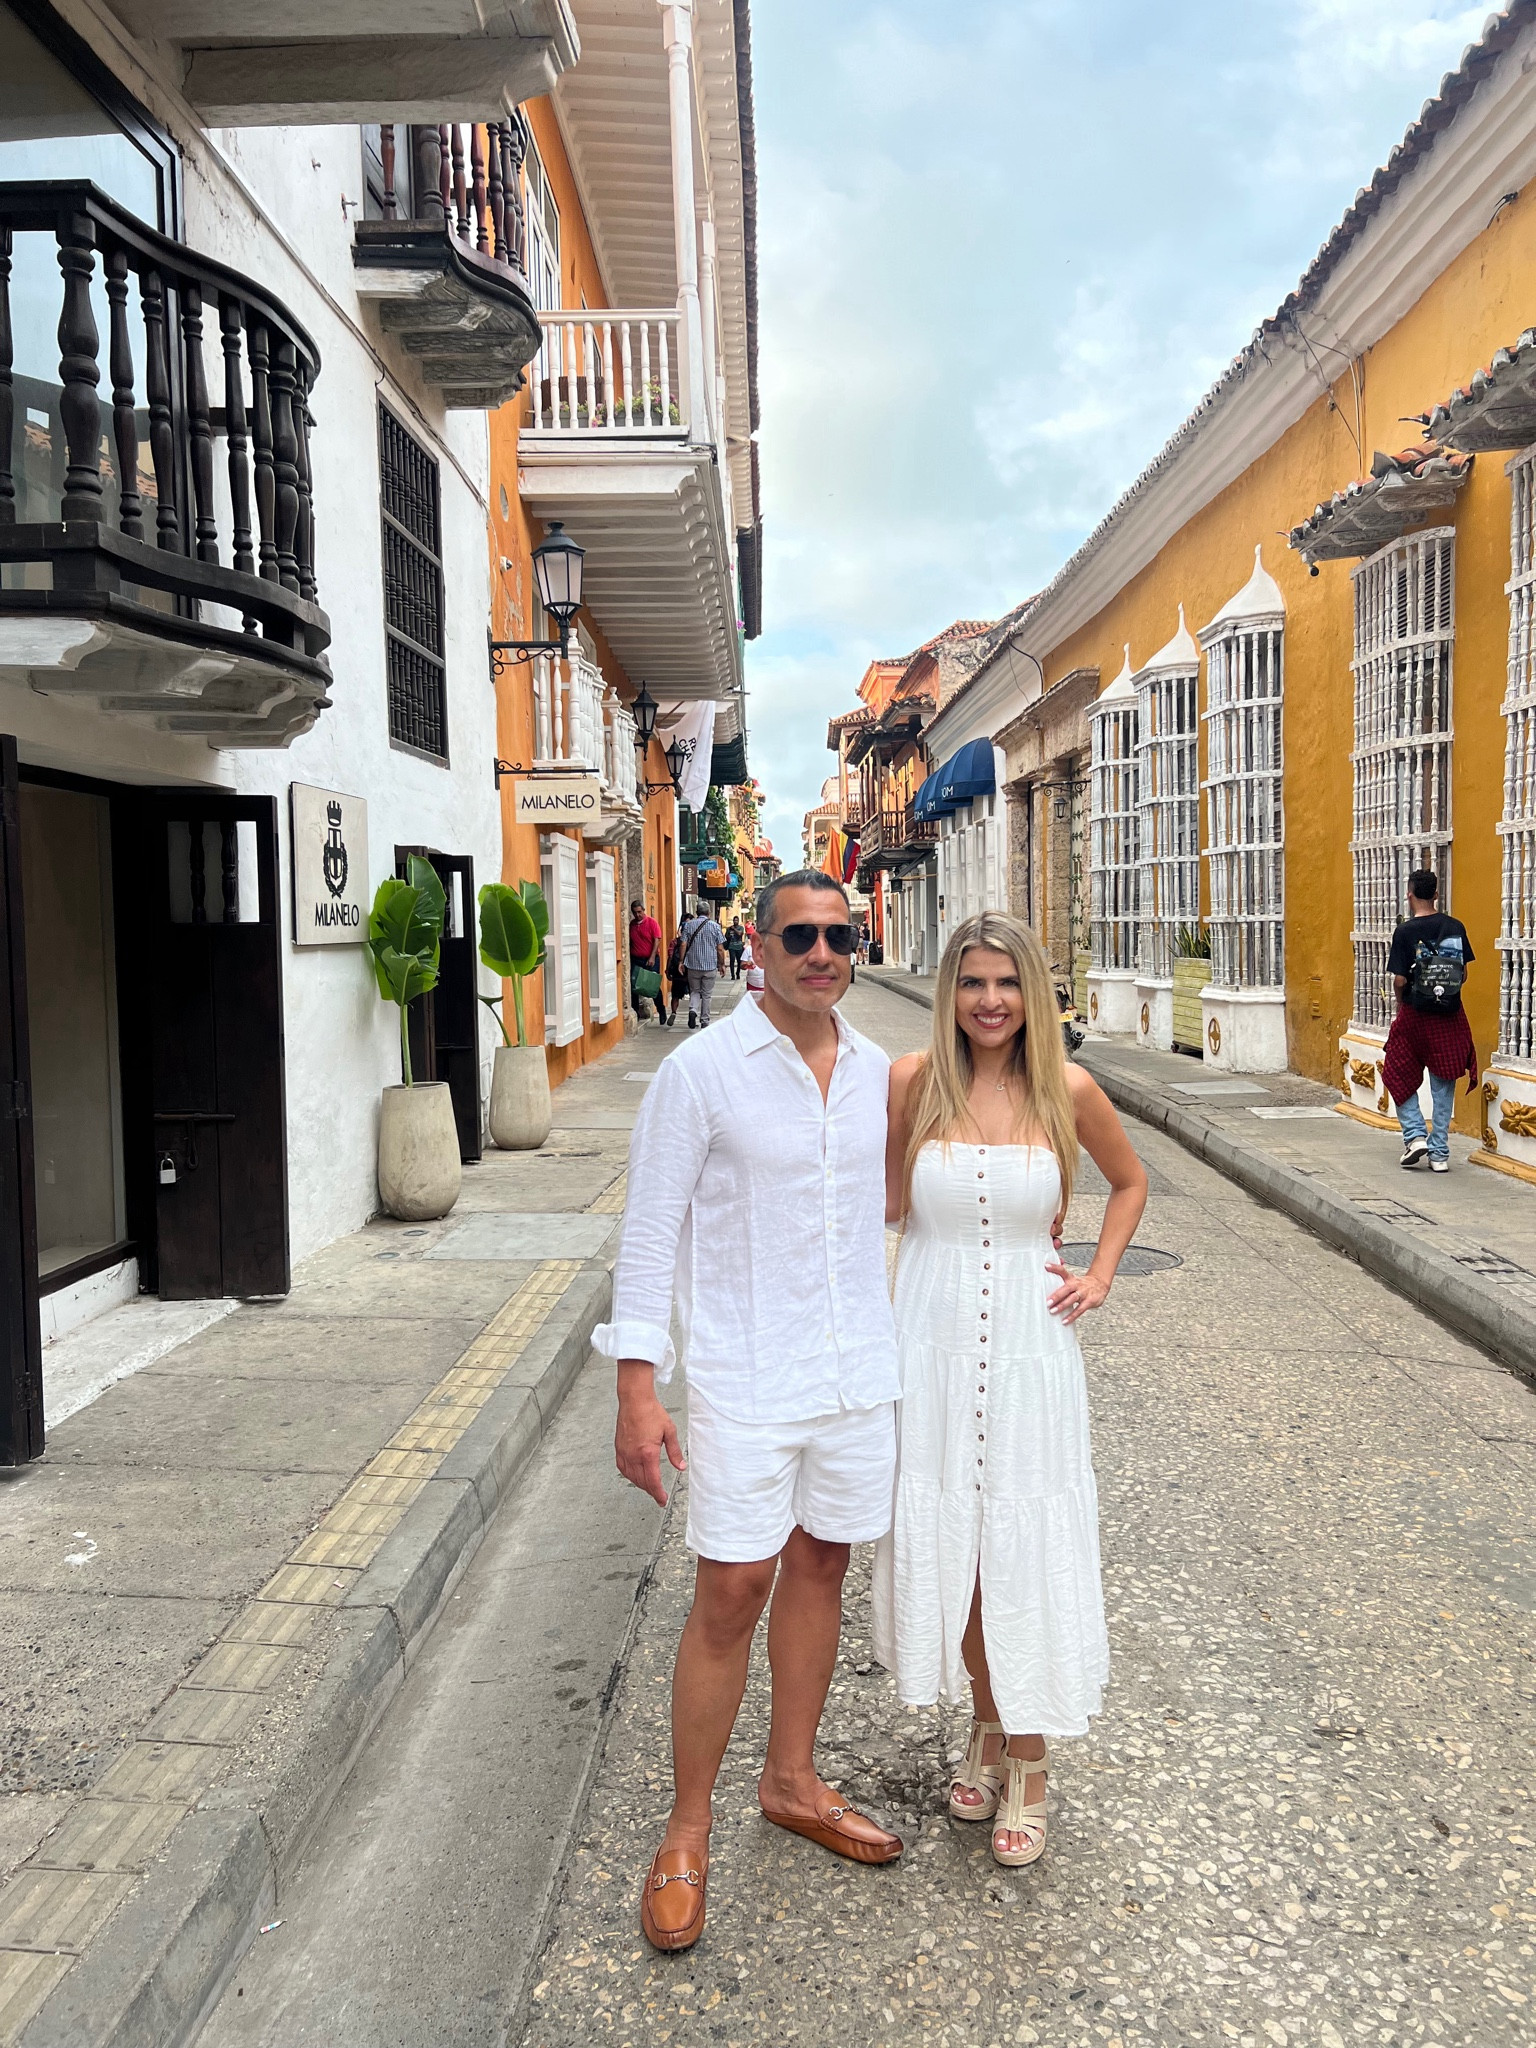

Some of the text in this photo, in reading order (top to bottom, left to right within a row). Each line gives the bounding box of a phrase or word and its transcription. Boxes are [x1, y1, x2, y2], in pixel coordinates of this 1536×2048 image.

[678, 738, 692, 763] CHA
[521, 794, 595, 809] MILANELO
[315, 902, 360, 927] MILANELO
